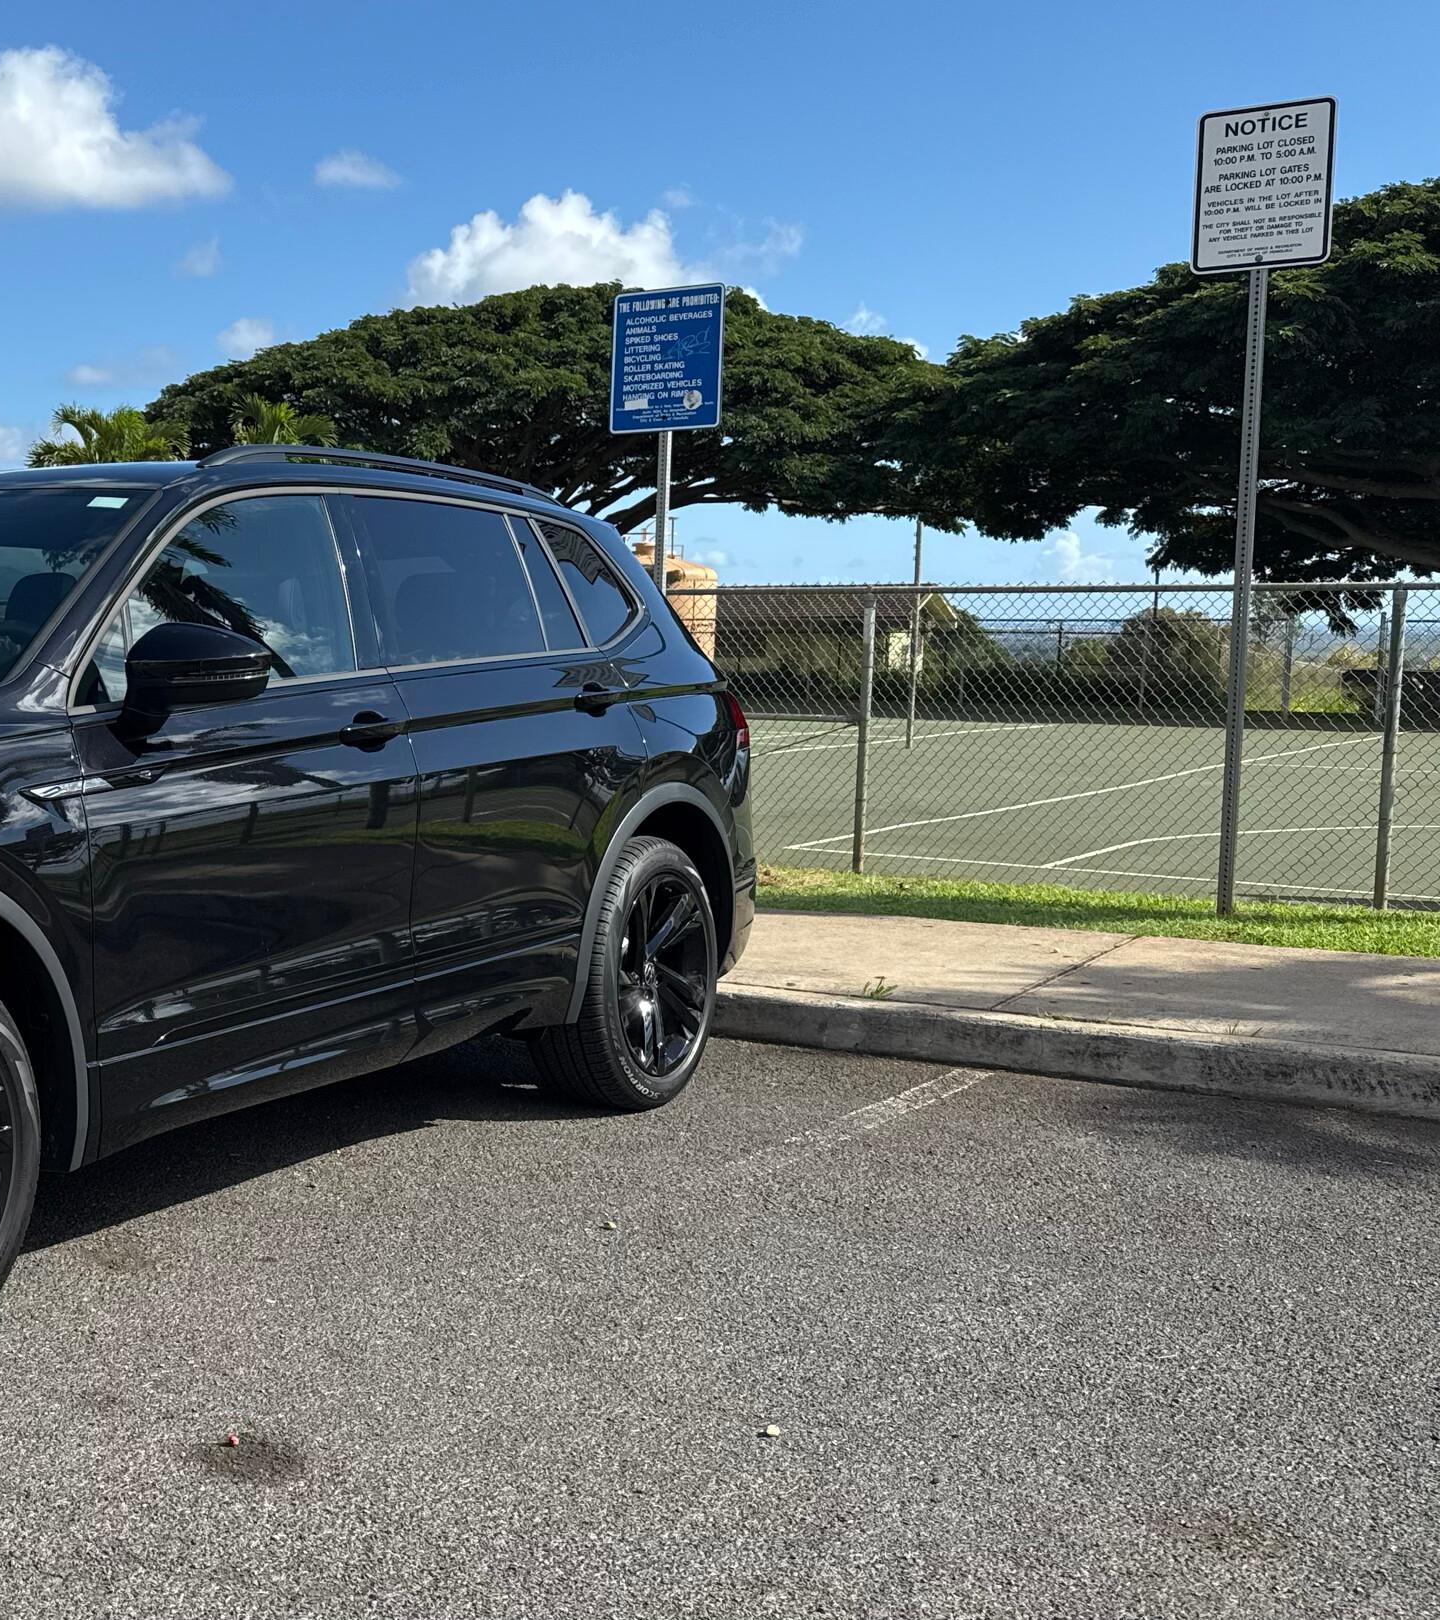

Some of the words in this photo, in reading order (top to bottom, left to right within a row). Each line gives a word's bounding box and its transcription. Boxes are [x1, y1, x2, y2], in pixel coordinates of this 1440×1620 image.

[1224, 112, 1309, 138] NOTICE
[1216, 143, 1254, 155] PARKING
[1257, 140, 1275, 151] LOT
[1277, 135, 1315, 148] CLOSED
[1213, 156, 1237, 166] 10:00
[1240, 154, 1257, 164] P.M.
[1260, 151, 1272, 160] TO
[1276, 149, 1297, 159] 5:00
[1298, 146, 1317, 156] A.M.
[1218, 170, 1257, 182] PARKING
[1260, 167, 1277, 177] LOT
[1280, 163, 1310, 175] GATES
[1204, 185, 1221, 194] ARE
[1225, 180, 1261, 192] LOCKED
[1264, 178, 1276, 187] AT
[1280, 175, 1304, 185] 10:00
[1305, 173, 1324, 182] P.M.
[1207, 199, 1244, 208] VEHICLES
[1276, 192, 1291, 201] LOT
[1294, 189, 1319, 198] AFTER
[1204, 208, 1224, 216] 10:00
[1244, 204, 1262, 212] WILL
[1265, 202, 1276, 210] BE
[1279, 199, 1311, 208] LOCKED
[1232, 219, 1251, 227] SHALL
[1253, 217, 1267, 225] NOT
[1278, 211, 1322, 221] RESPONSIBLE
[1266, 222, 1292, 230] DAMAGE
[1222, 234, 1248, 242] VEHICLE
[1301, 226, 1314, 234] LOT
[619, 302, 630, 313] THE
[632, 298, 666, 312] FOLLOWING
[681, 293, 720, 307] PROHIBITED:
[625, 314, 667, 326] ALCOHOLIC
[669, 310, 713, 321] BEVERAGES
[625, 326, 656, 335] ANIMALS
[625, 336, 651, 345] SPIKED
[653, 332, 679, 342] SHOES
[624, 344, 660, 354] LITTERING
[623, 353, 661, 364] BICYCLING
[623, 363, 651, 373] ROLLER
[654, 361, 685, 371] SKATING
[623, 370, 684, 383] SKATEBOARDING
[623, 381, 664, 392] MOTORIZED
[667, 378, 702, 389] VEHICLES
[622, 391, 655, 401] HANGING
[657, 391, 668, 399] ON
[671, 389, 689, 398] RIMS
[618, 1055, 662, 1100] SCORPION
